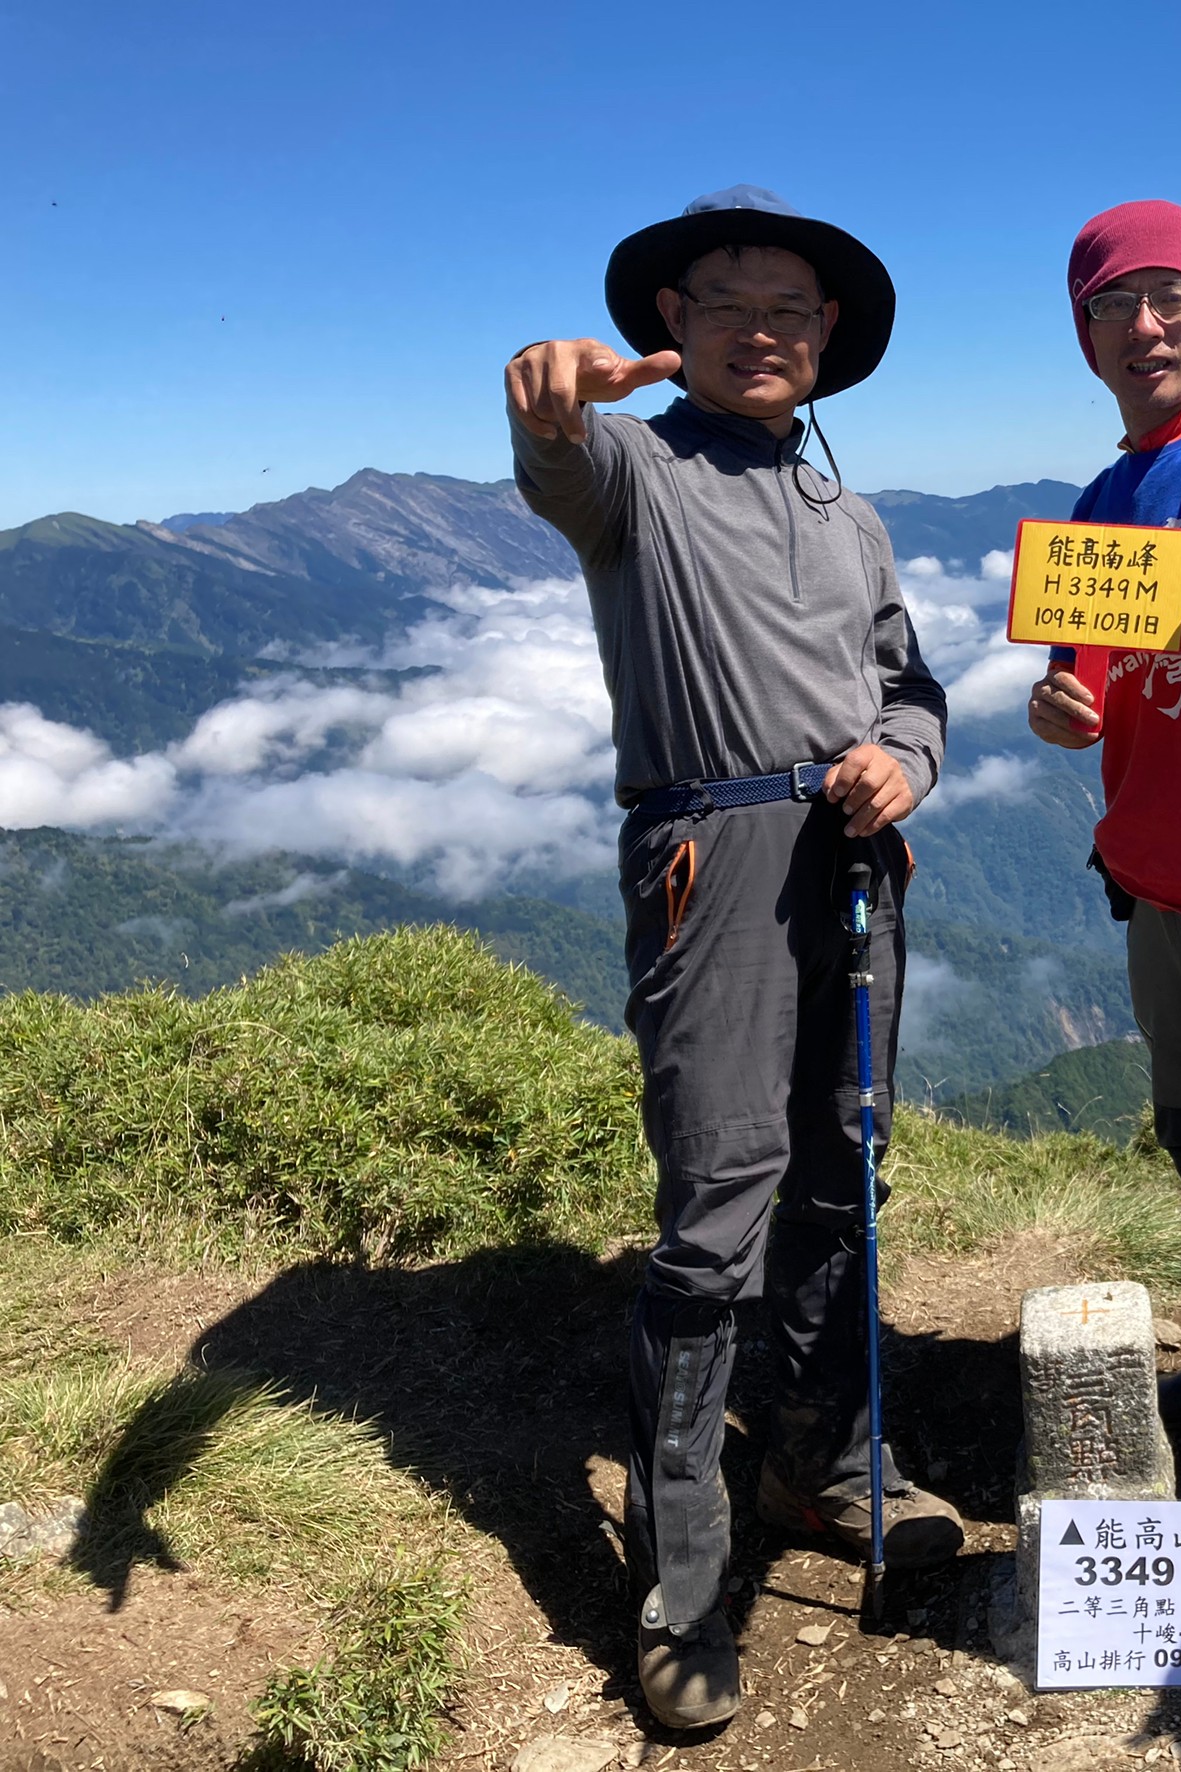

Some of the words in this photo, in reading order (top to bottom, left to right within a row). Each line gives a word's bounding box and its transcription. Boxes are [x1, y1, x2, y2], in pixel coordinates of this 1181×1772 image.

[1046, 534, 1159, 575] 能高南峰
[1034, 606, 1160, 635] 109年10月1日
[1074, 1555, 1175, 1586] 3349
[1057, 1595, 1175, 1618] 二等三角點
[1053, 1649, 1146, 1672] 高山排行
